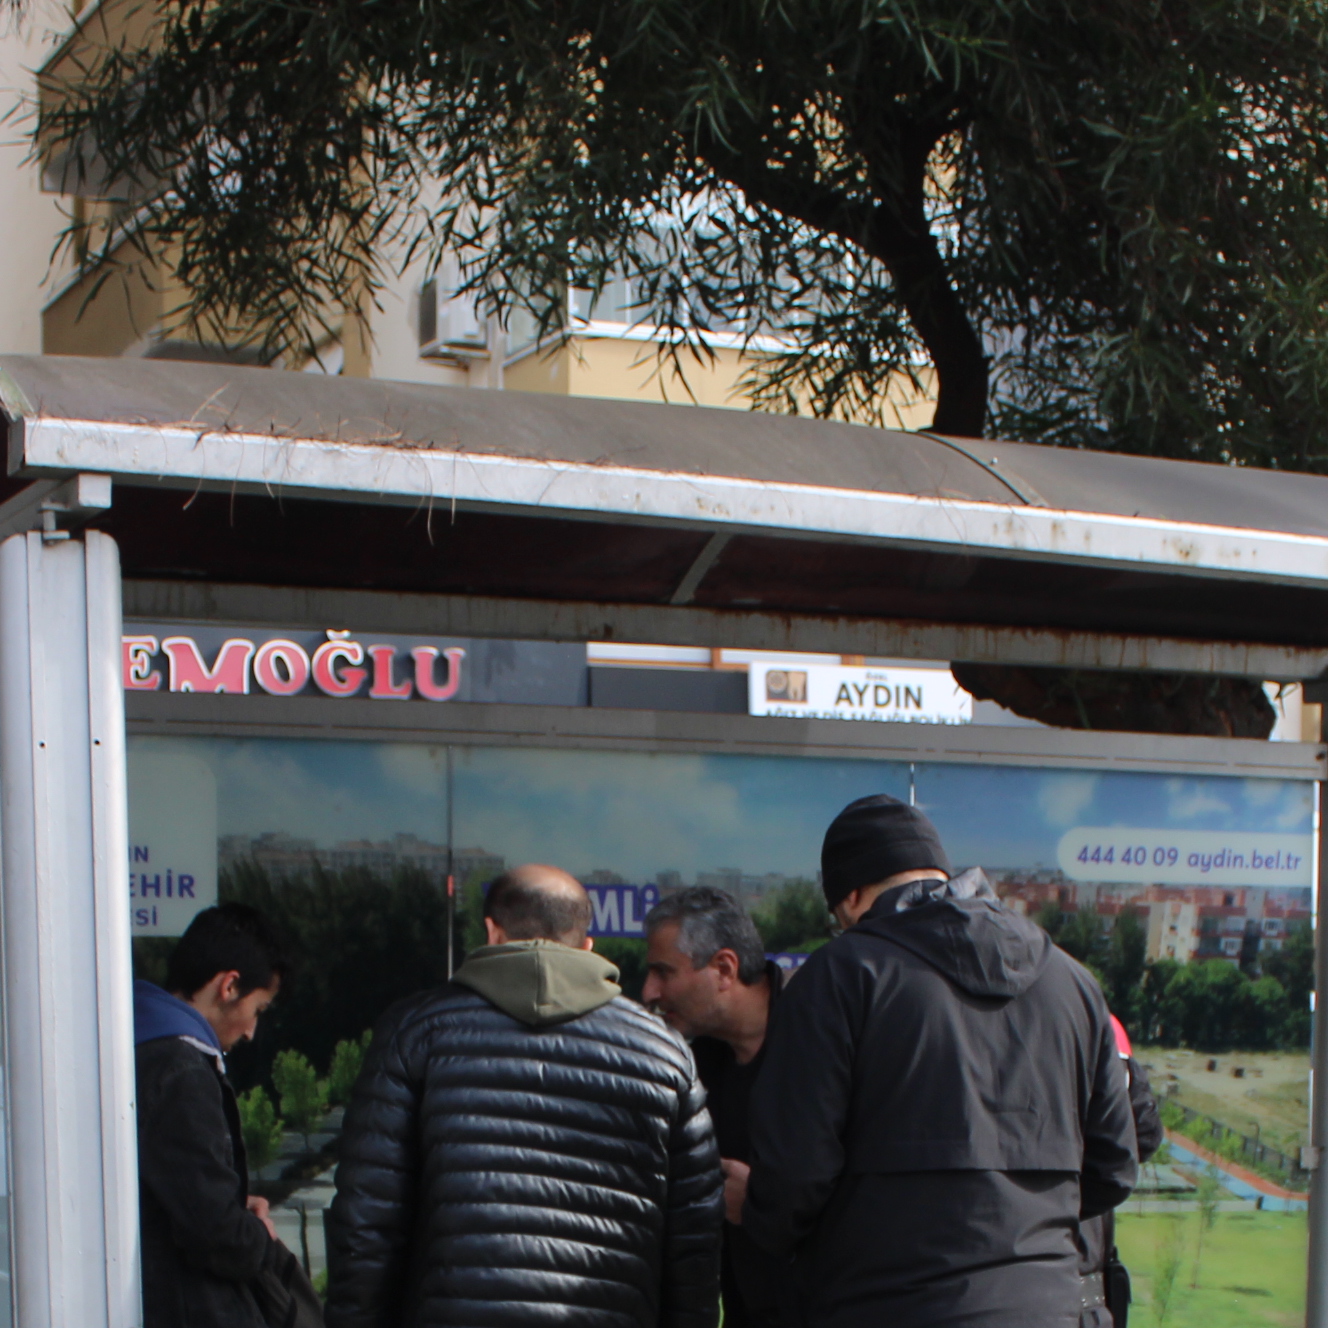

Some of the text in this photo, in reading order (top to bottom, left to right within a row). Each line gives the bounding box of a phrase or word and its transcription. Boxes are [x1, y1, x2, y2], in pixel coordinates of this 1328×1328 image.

[835, 682, 923, 710] AYDIN
[1077, 845, 1302, 873] 444 40 09 aydin.bel.tr
[131, 905, 157, 926] Sİ
